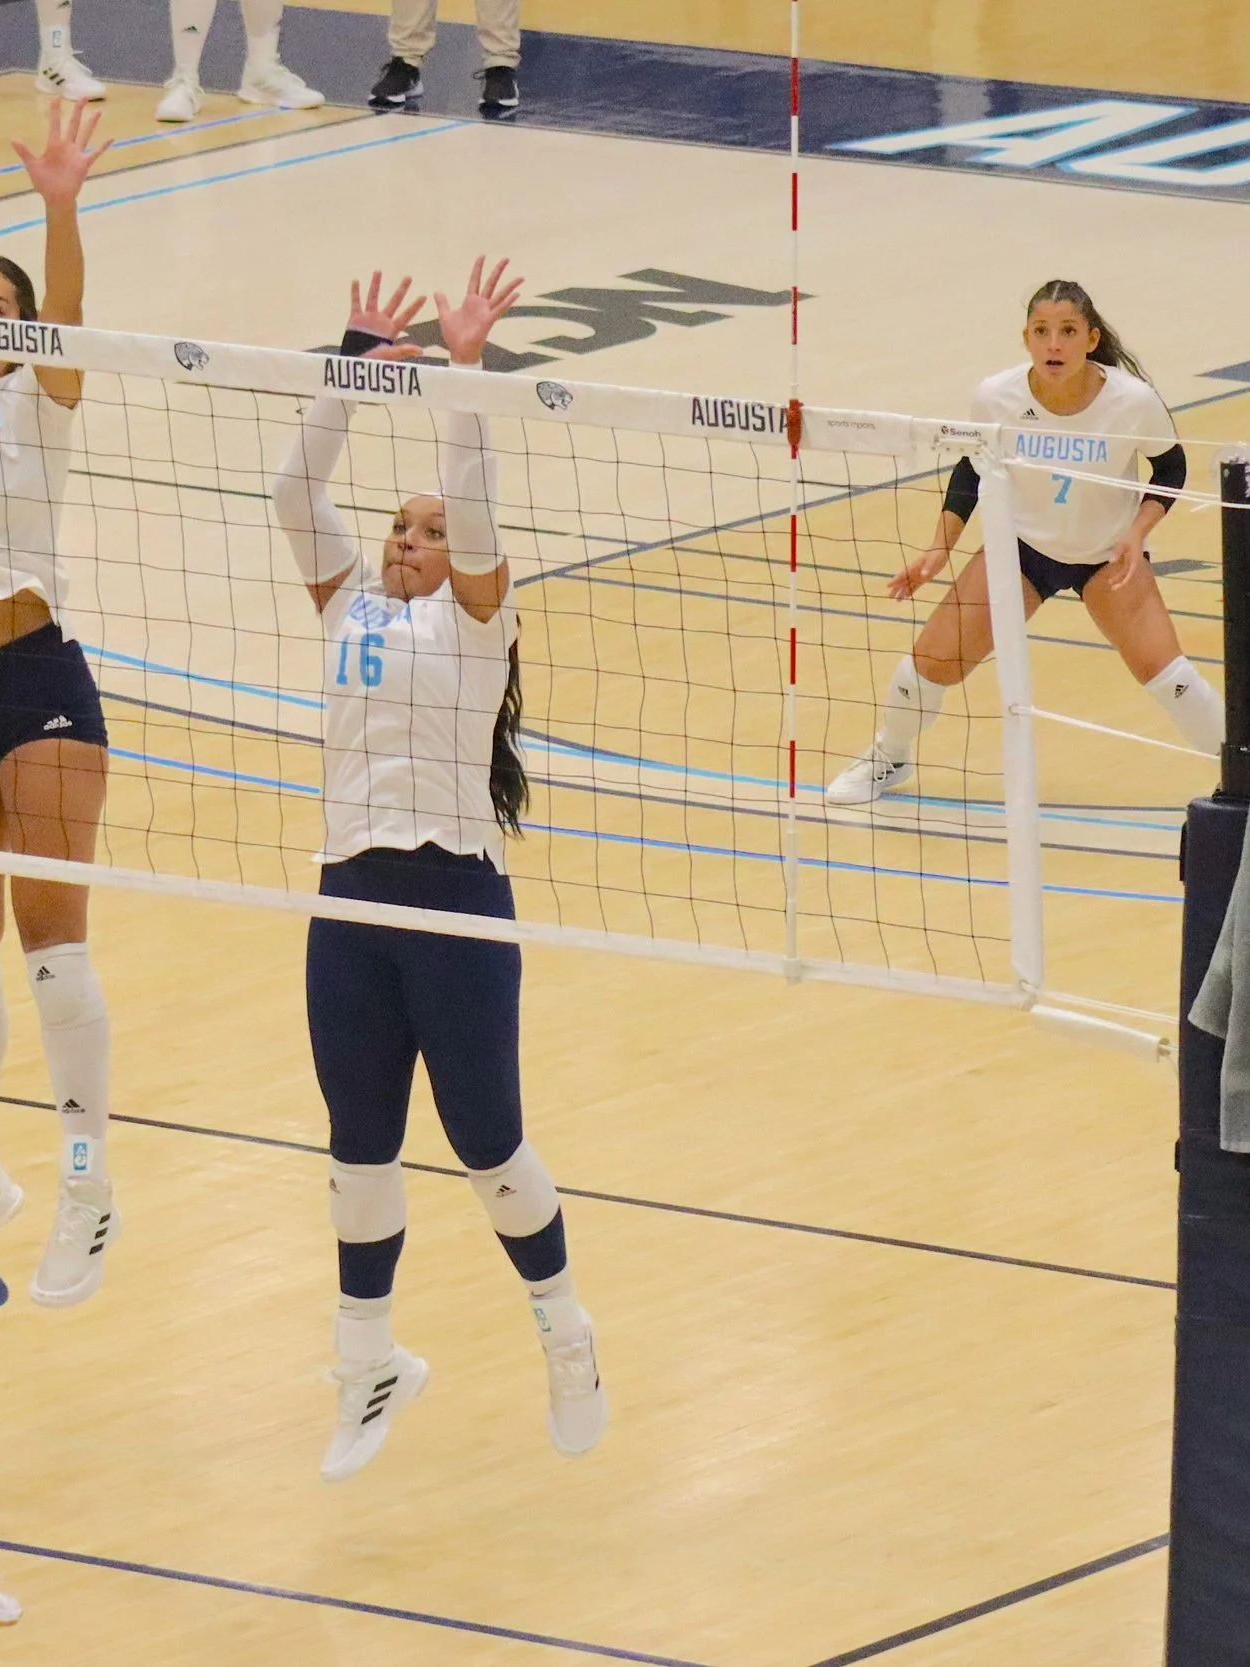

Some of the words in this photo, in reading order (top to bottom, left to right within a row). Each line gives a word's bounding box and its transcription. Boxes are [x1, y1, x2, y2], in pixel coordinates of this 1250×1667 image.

[324, 358, 422, 397] AUGUSTA
[950, 427, 982, 438] Senoh
[1015, 433, 1108, 463] AUGUSTA
[1051, 472, 1073, 504] 7
[336, 632, 386, 688] 16
